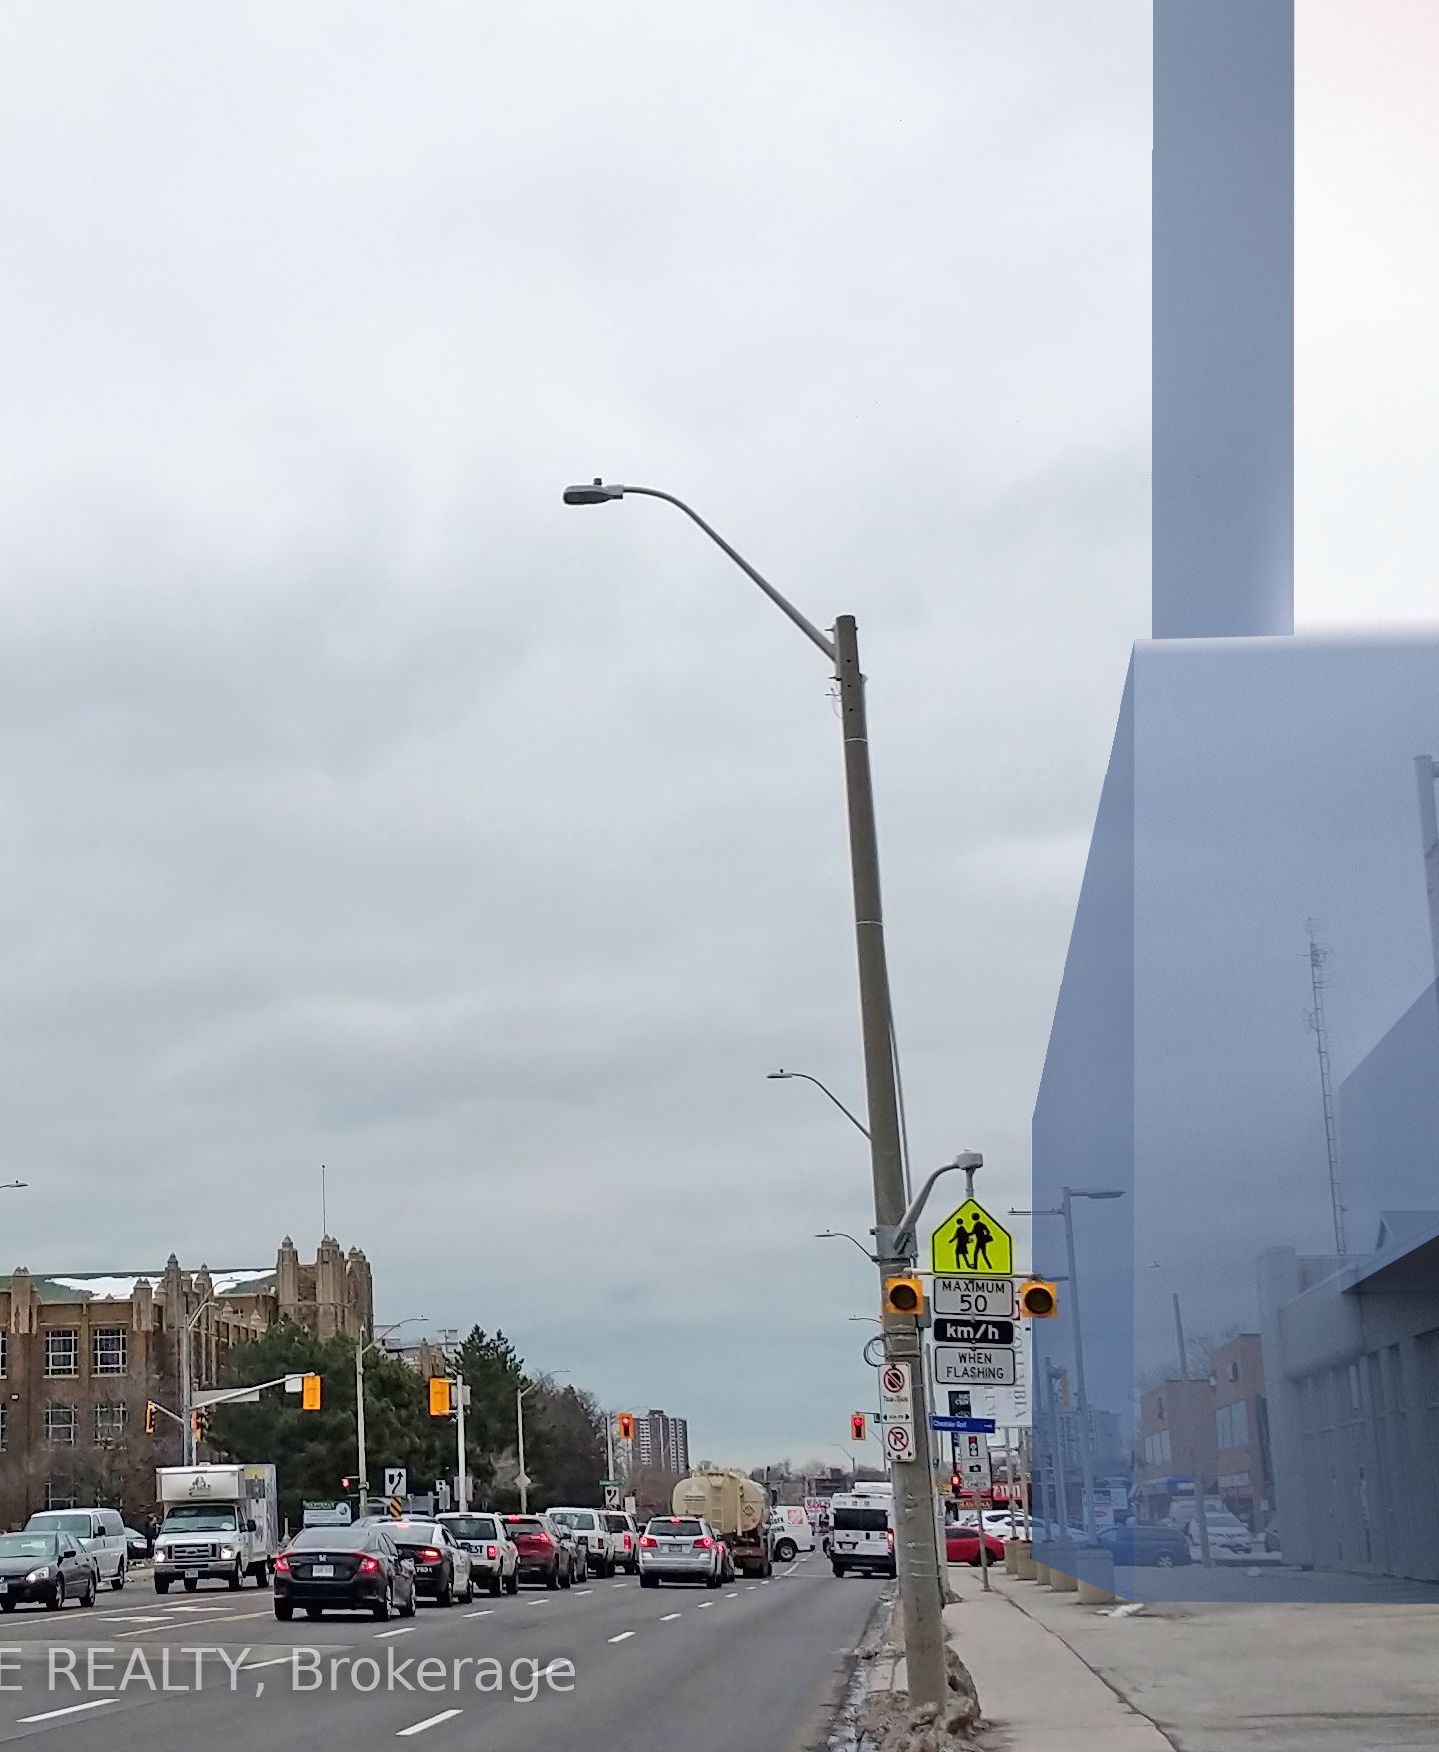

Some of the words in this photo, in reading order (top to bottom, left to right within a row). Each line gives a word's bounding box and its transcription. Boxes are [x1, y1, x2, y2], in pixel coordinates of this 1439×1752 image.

[942, 1280, 1005, 1294] MAXIMUM
[960, 1294, 987, 1312] 50
[946, 1322, 1000, 1340] km/h
[957, 1352, 992, 1364] WHEN
[946, 1366, 1004, 1379] FLASHING
